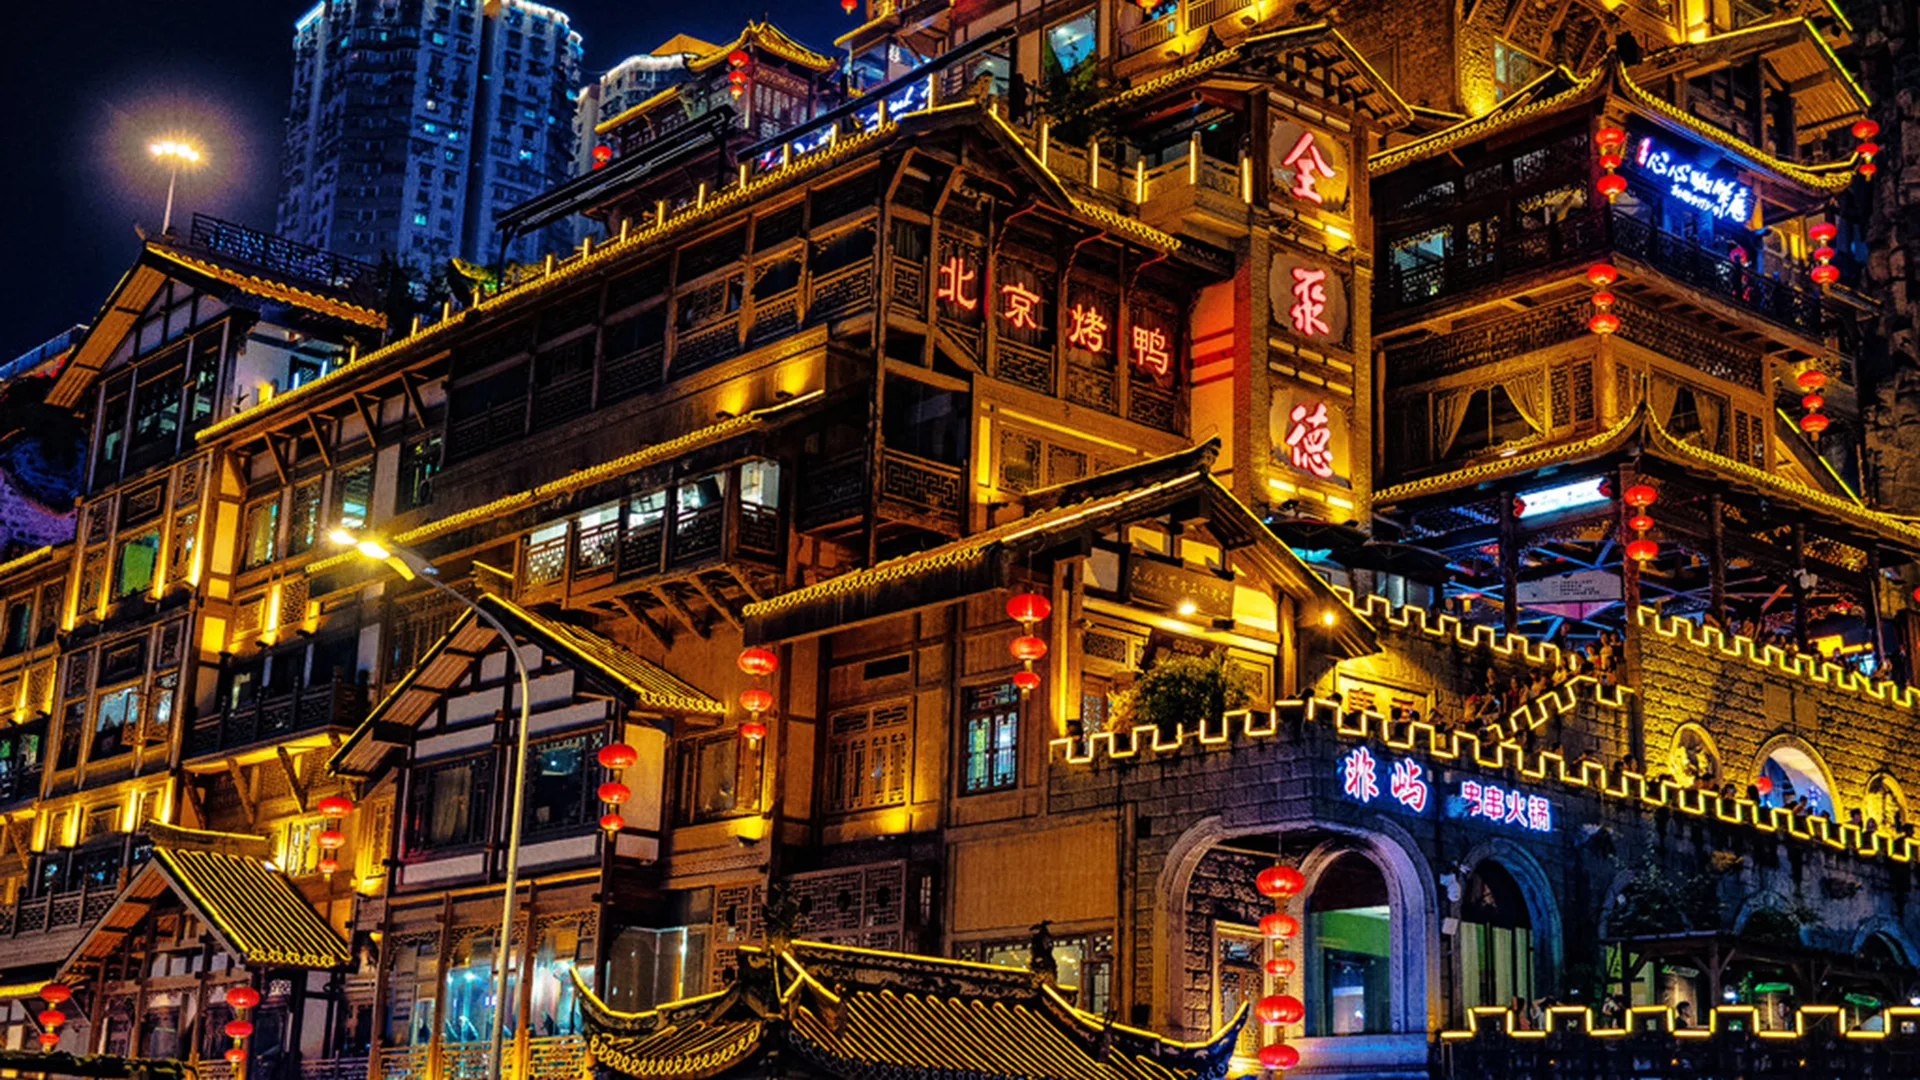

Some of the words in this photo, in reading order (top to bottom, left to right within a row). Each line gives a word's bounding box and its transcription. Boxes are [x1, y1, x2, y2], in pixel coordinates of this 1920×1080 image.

[937, 256, 1169, 375] 北京烤鸭
[1462, 781, 1550, 831] 串串火锅
